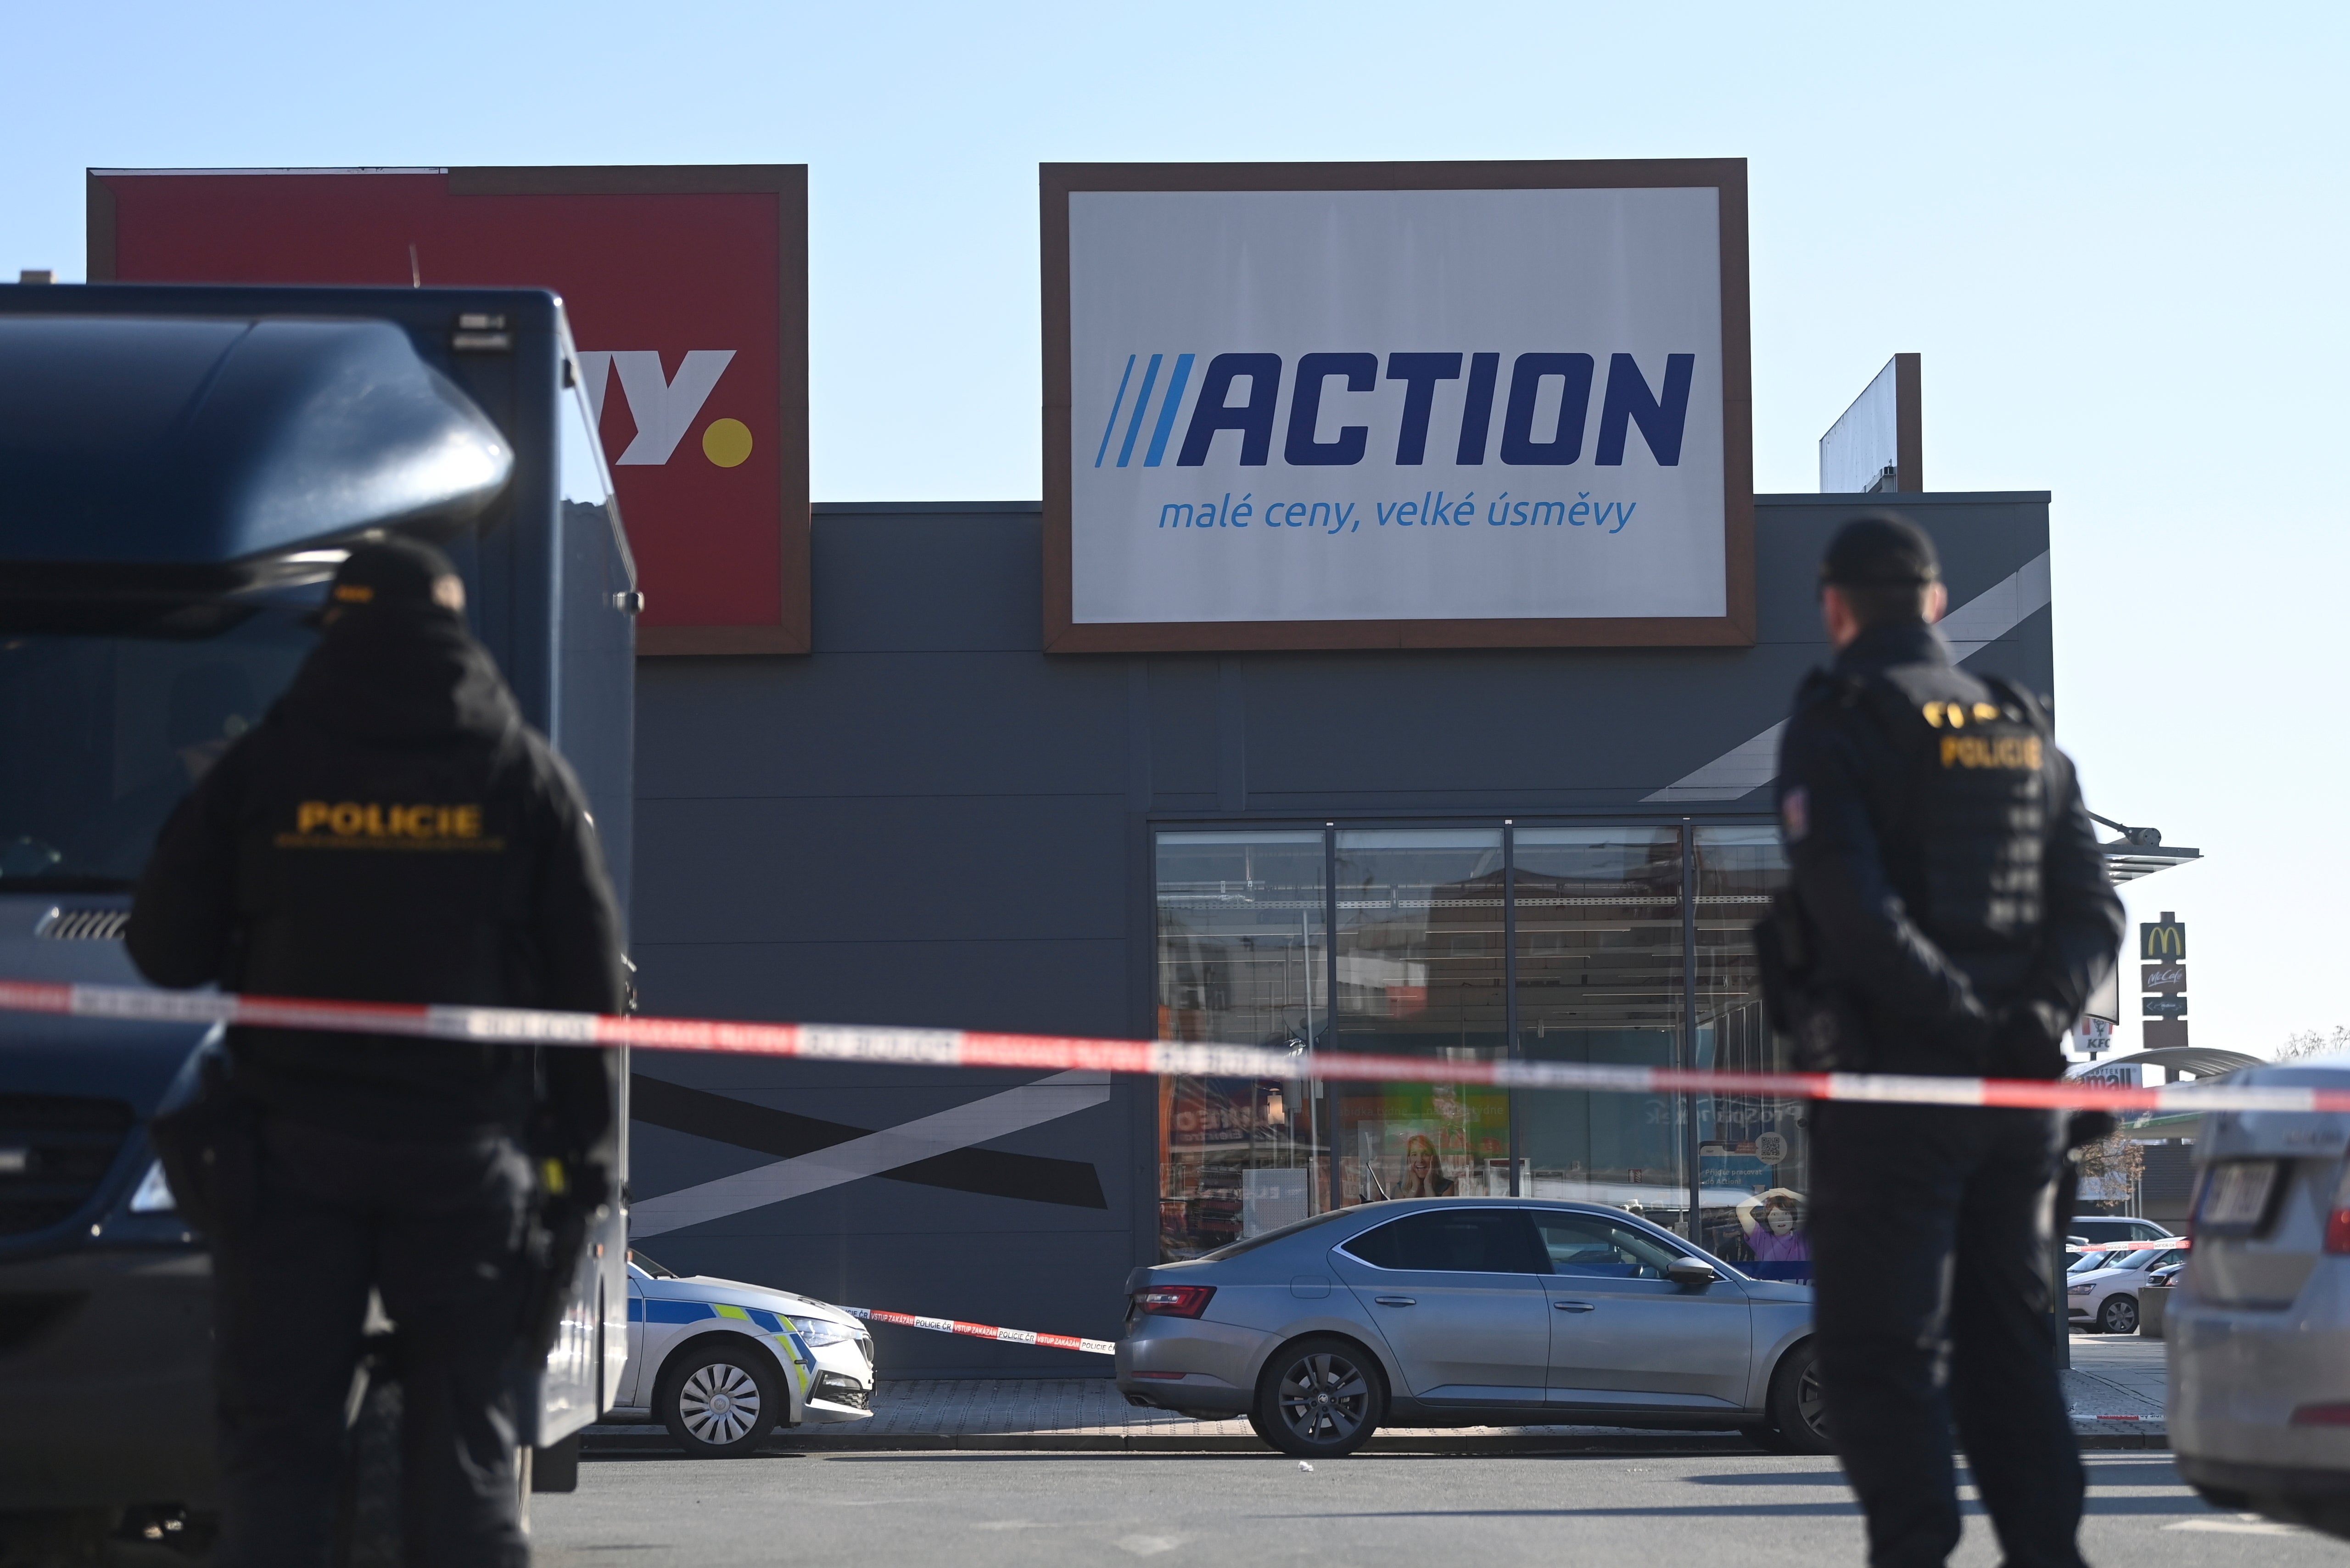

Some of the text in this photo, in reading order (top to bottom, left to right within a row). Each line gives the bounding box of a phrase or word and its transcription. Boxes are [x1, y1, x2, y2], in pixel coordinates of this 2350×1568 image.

[1176, 353, 1695, 466] ACTION
[1159, 492, 1636, 534] malé ceny, velké úsměvy
[1941, 736, 2042, 769] POLICIE
[297, 801, 482, 838] POLICIE
[2087, 1038, 2110, 1048] KFC
[859, 1310, 868, 1318] ČR
[871, 1312, 887, 1321] VSTUP
[889, 1314, 914, 1325] ZAKÁZÁN
[916, 1319, 940, 1329] POLICIE
[942, 1322, 951, 1330] ČR
[954, 1324, 971, 1333] VSTUP
[972, 1326, 997, 1337] ZAKÁZÁN
[999, 1331, 1023, 1340] POLICIE
[1025, 1333, 1034, 1342] ČR
[1037, 1336, 1054, 1344] VSTUP
[1054, 1338, 1079, 1347] ZAKÁZÁN
[1082, 1342, 1107, 1350] POLICIE
